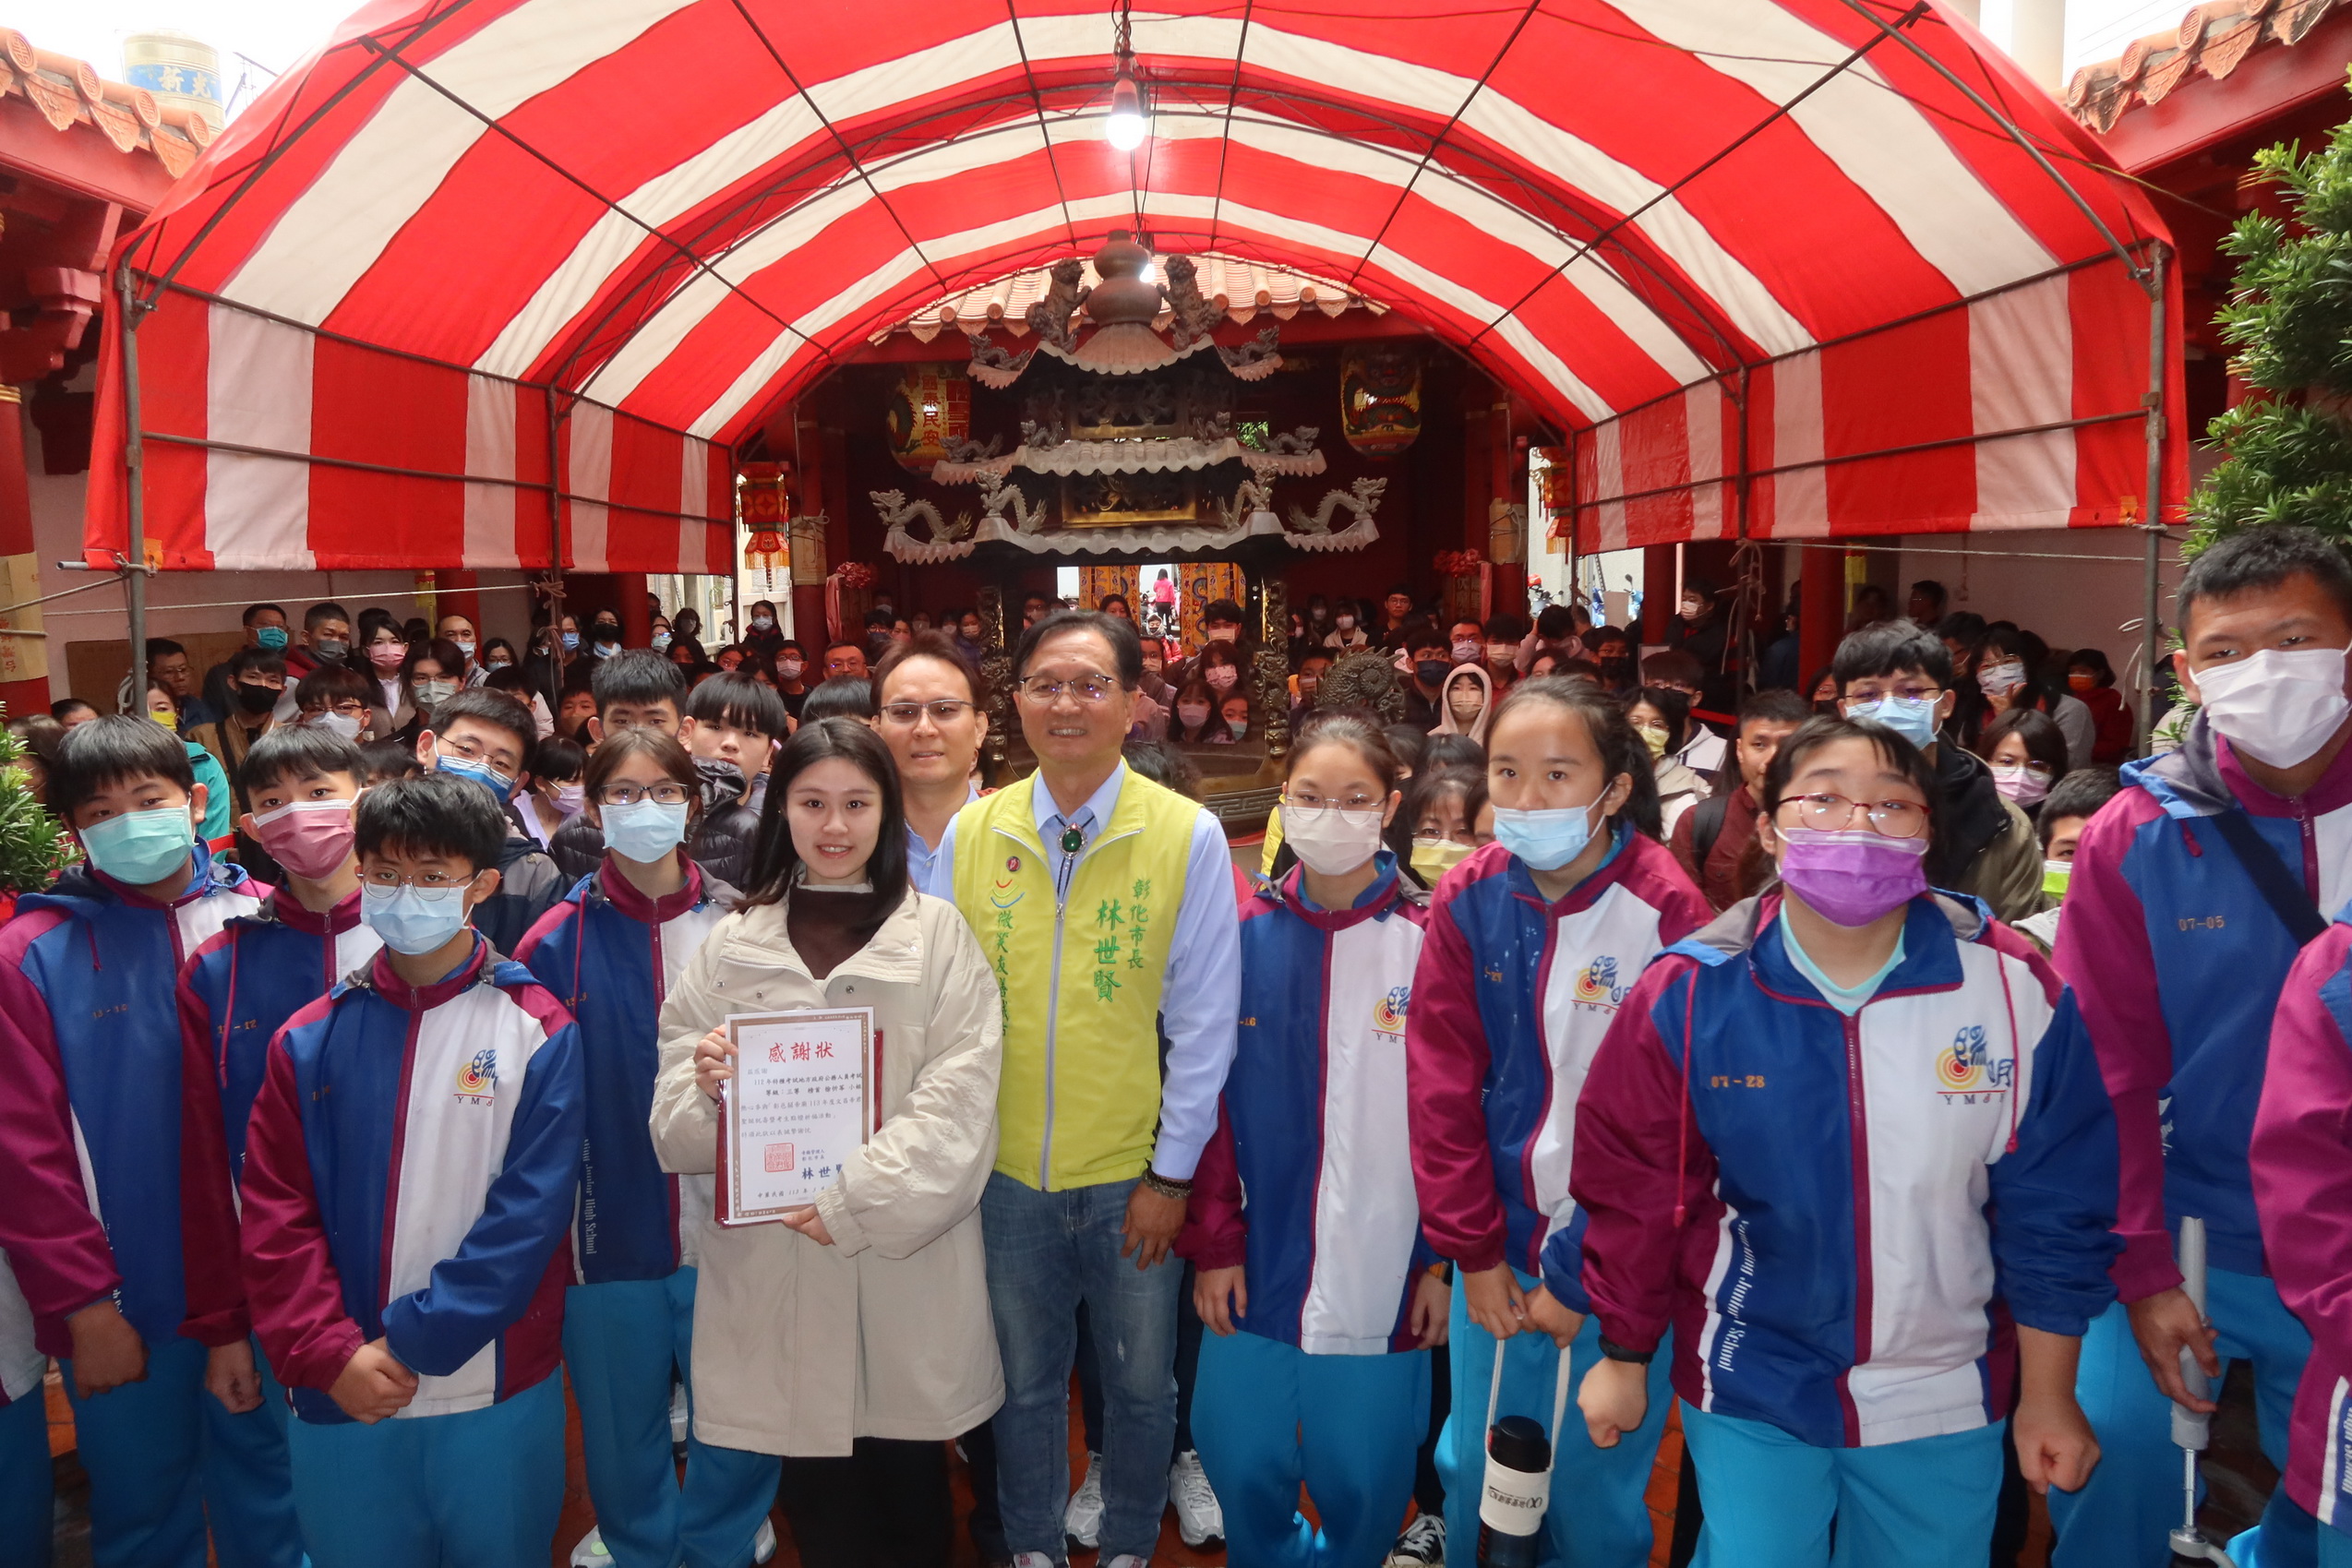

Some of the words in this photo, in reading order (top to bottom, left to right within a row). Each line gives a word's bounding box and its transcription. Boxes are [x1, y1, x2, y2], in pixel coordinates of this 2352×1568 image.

[1127, 879, 1151, 970] 彰化市長
[2178, 915, 2225, 931] 07-05
[1094, 899, 1125, 1003] 林世賢
[217, 1019, 258, 1035] 1-12
[768, 1040, 835, 1063] 感謝狀
[1710, 1074, 1765, 1088] 07-28
[585, 1164, 594, 1196] Junior
[584, 1198, 597, 1221] High
[585, 1223, 598, 1255] School
[1727, 1276, 1753, 1320] Junior
[1717, 1327, 1746, 1373] School
